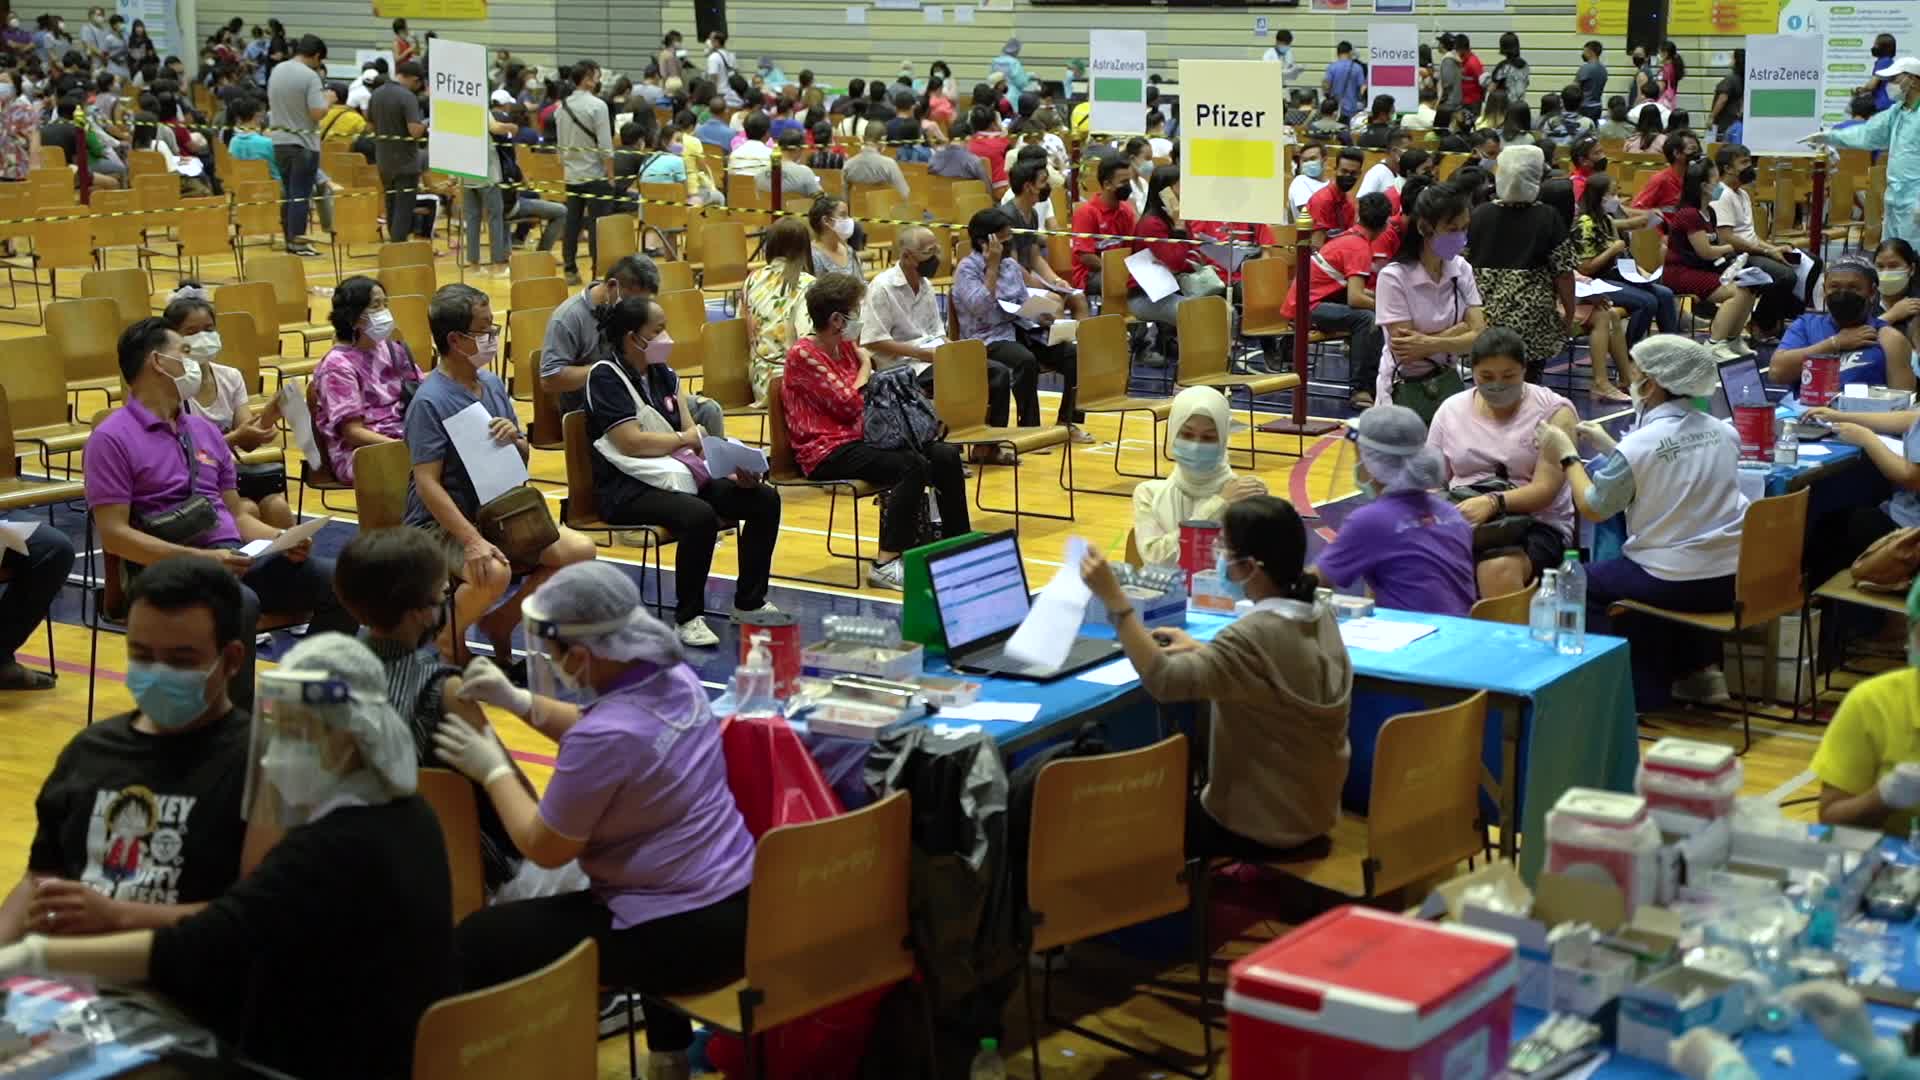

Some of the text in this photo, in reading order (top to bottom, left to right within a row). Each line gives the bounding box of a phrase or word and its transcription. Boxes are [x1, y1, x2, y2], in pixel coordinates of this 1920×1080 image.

[1371, 47, 1415, 59] Sinovac
[1093, 59, 1145, 71] AstraZeneca
[1749, 67, 1819, 81] AstraZeneca
[436, 72, 482, 96] Pfizer
[1196, 104, 1266, 128] Pfizer
